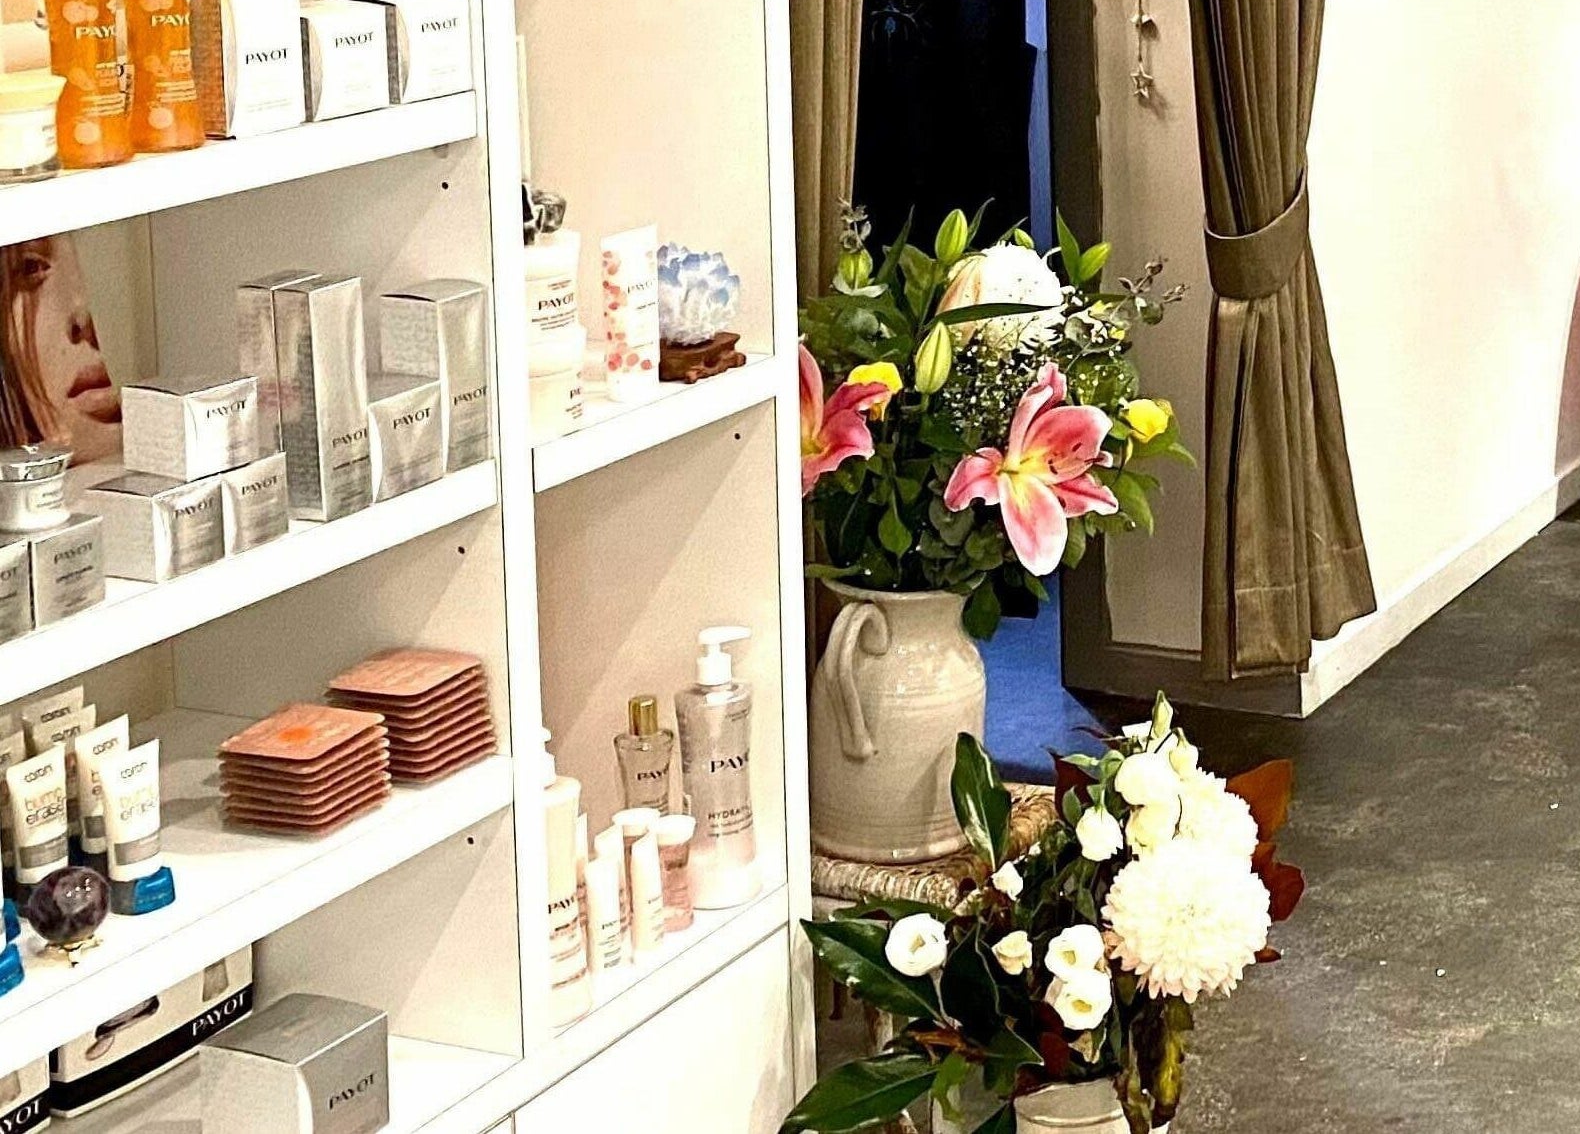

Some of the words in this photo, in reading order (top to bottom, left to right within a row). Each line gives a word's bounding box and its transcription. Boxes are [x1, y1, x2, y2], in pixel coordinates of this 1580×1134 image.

[421, 17, 460, 33] PAYOT
[334, 31, 375, 48] PAYOT
[245, 48, 289, 65] PAYOT
[453, 386, 487, 406] PAYOT
[206, 400, 247, 419] PAYOT
[393, 407, 431, 430] PAYOT
[332, 428, 368, 448] PAYOT
[241, 475, 278, 496] PAYOT
[173, 497, 215, 518] PAYOT
[191, 991, 248, 1037] PAYOT
[328, 1073, 376, 1111] PAYOT
